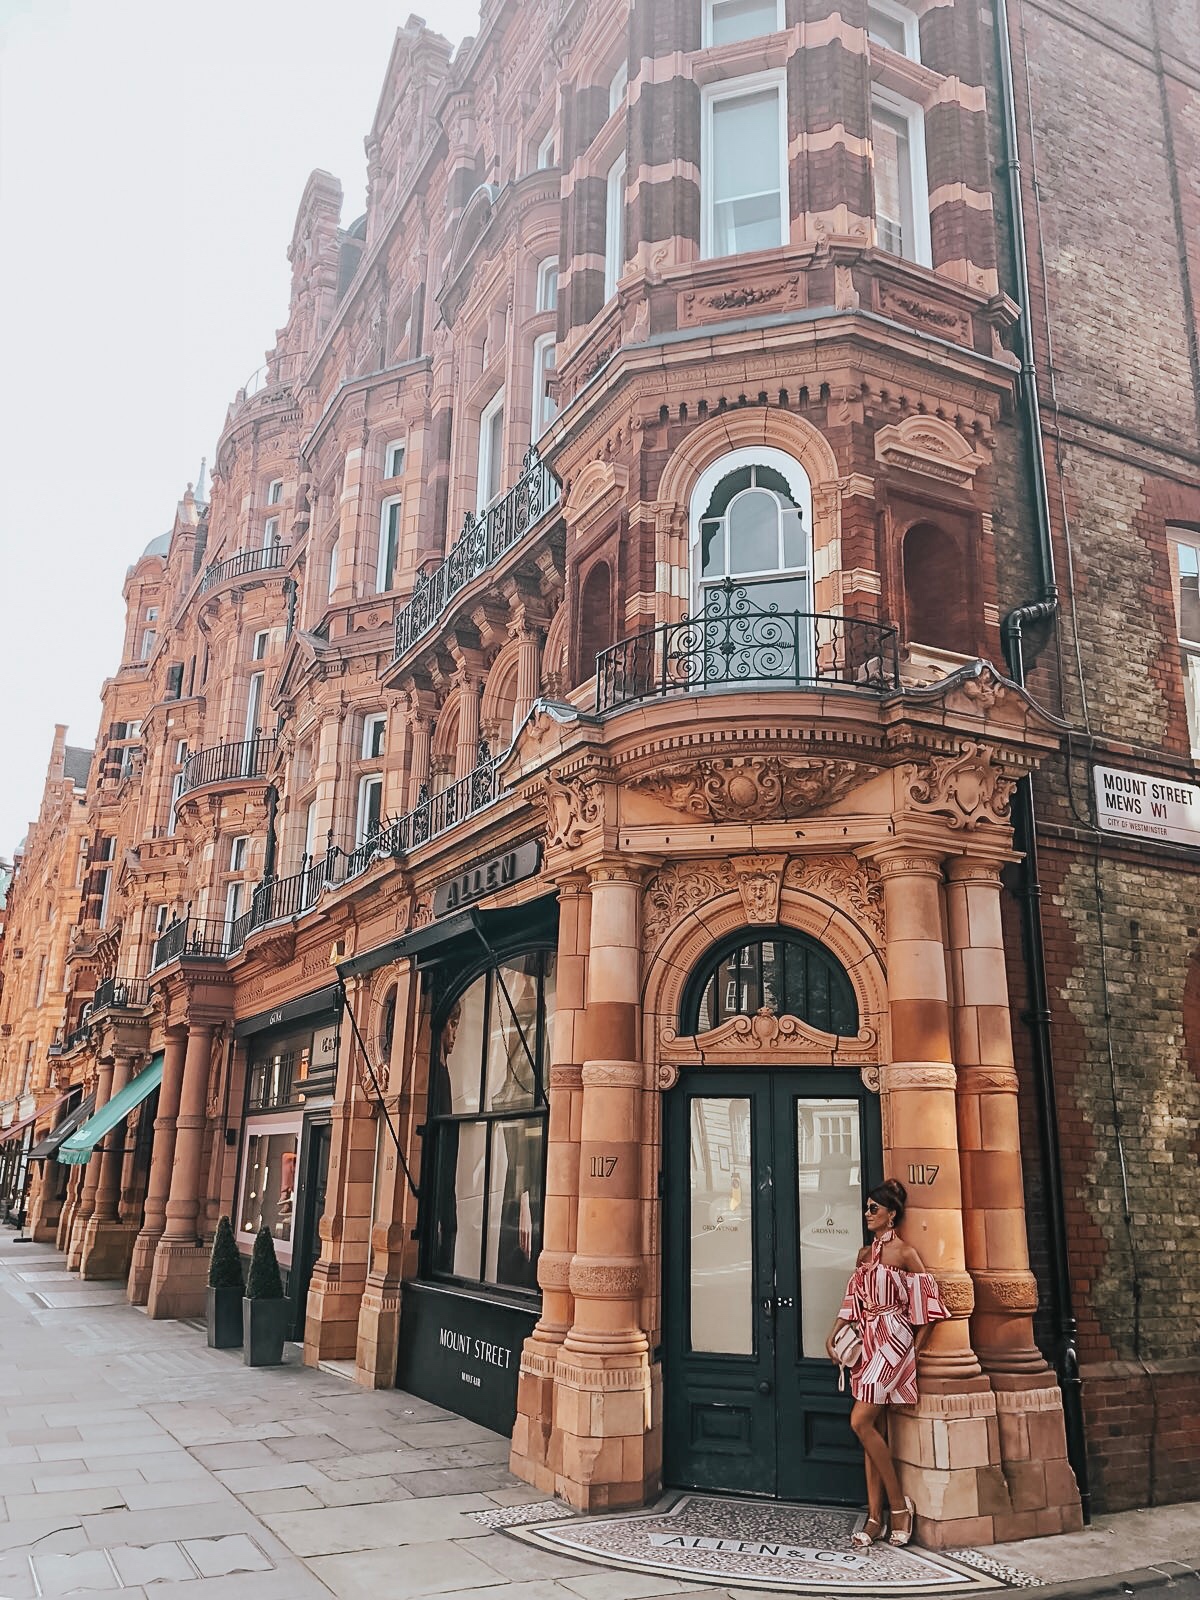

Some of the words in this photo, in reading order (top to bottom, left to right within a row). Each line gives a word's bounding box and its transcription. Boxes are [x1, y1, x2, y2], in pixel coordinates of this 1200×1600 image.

[1103, 773, 1147, 797] MOUNT
[1151, 784, 1193, 806] STREET
[1105, 792, 1142, 815] MEWS
[1150, 801, 1168, 819] W1
[1107, 817, 1120, 827] CITY
[1121, 820, 1129, 828] OF
[1129, 822, 1168, 836] WESTMINSTER
[446, 852, 516, 909] ALLEN
[590, 1156, 618, 1178] 117
[908, 1164, 940, 1186] 117
[440, 1327, 472, 1355] MOUNT
[474, 1339, 512, 1369] STREET
